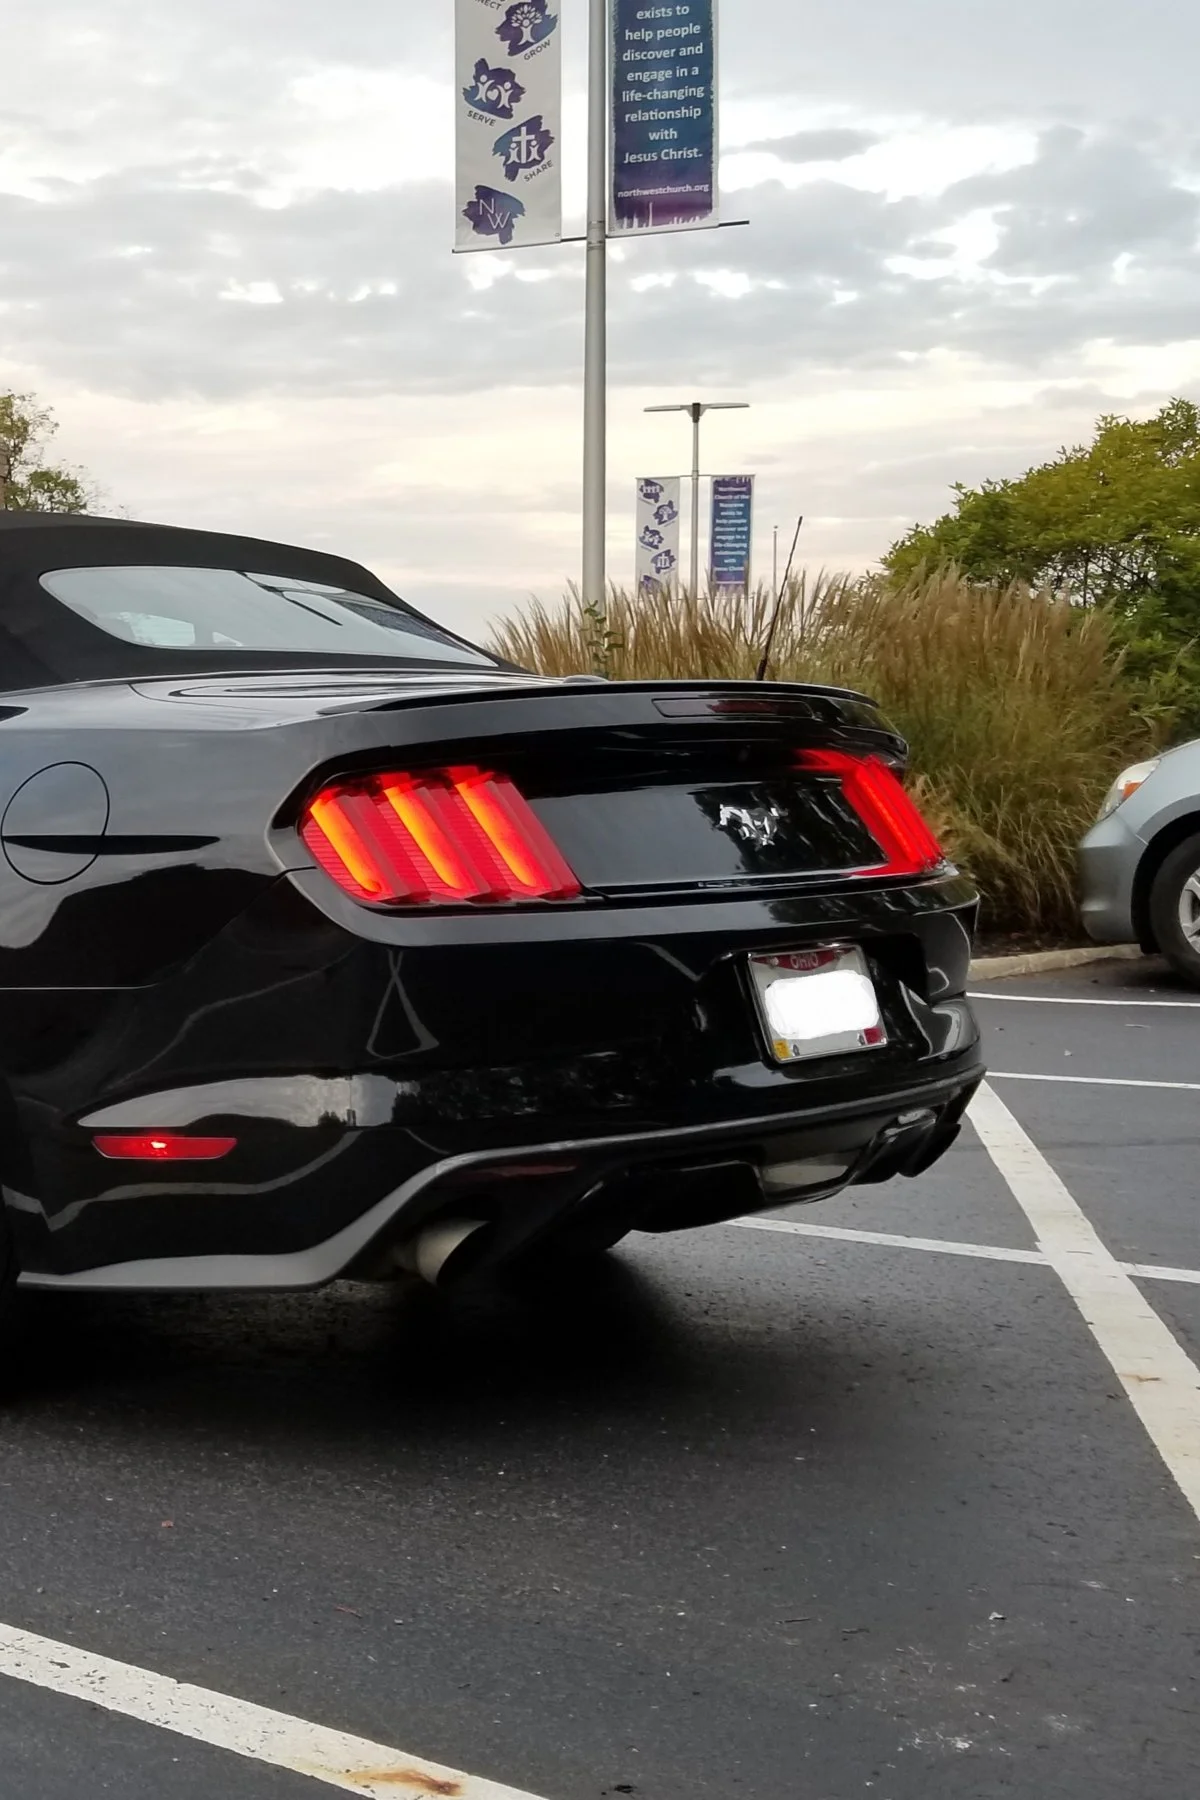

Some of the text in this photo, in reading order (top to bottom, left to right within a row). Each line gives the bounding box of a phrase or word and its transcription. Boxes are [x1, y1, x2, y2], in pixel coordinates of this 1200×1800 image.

[636, 5, 689, 19] exists to
[625, 23, 701, 41] help people
[523, 39, 551, 60] GROW
[623, 42, 703, 61] discover and
[627, 66, 699, 82] engage in a
[622, 86, 705, 102] life-changing
[467, 110, 496, 126] SERVE
[625, 106, 701, 122] relationship
[648, 128, 677, 140] with
[624, 147, 703, 163] Jesus Christ.
[523, 160, 553, 182] SHARE
[617, 184, 710, 198] northwestchurch.org
